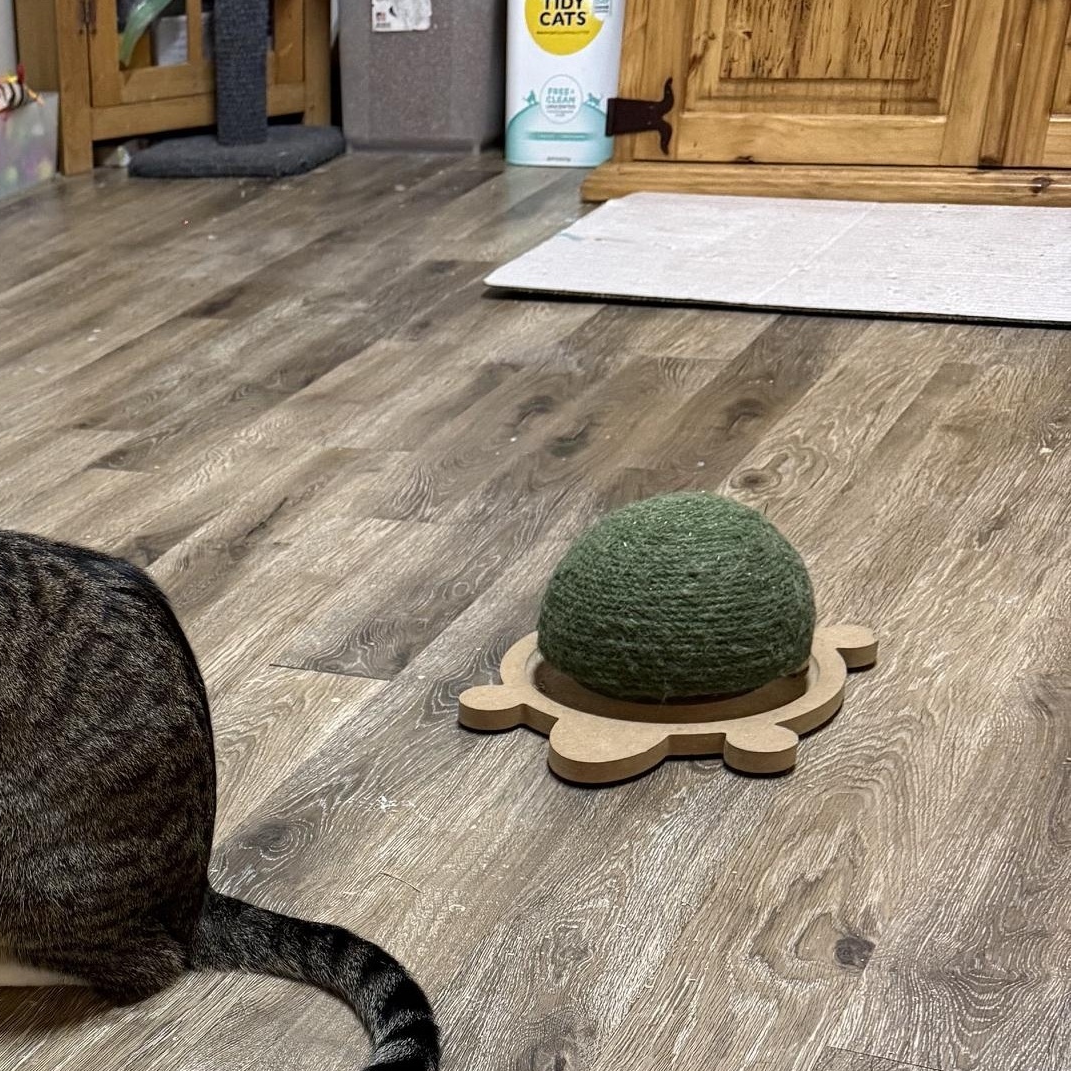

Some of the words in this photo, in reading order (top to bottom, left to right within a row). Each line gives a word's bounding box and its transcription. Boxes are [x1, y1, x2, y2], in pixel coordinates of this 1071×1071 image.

[544, 0, 583, 10] TIDY
[540, 12, 586, 26] CATS
[545, 96, 576, 104] CLEAN
